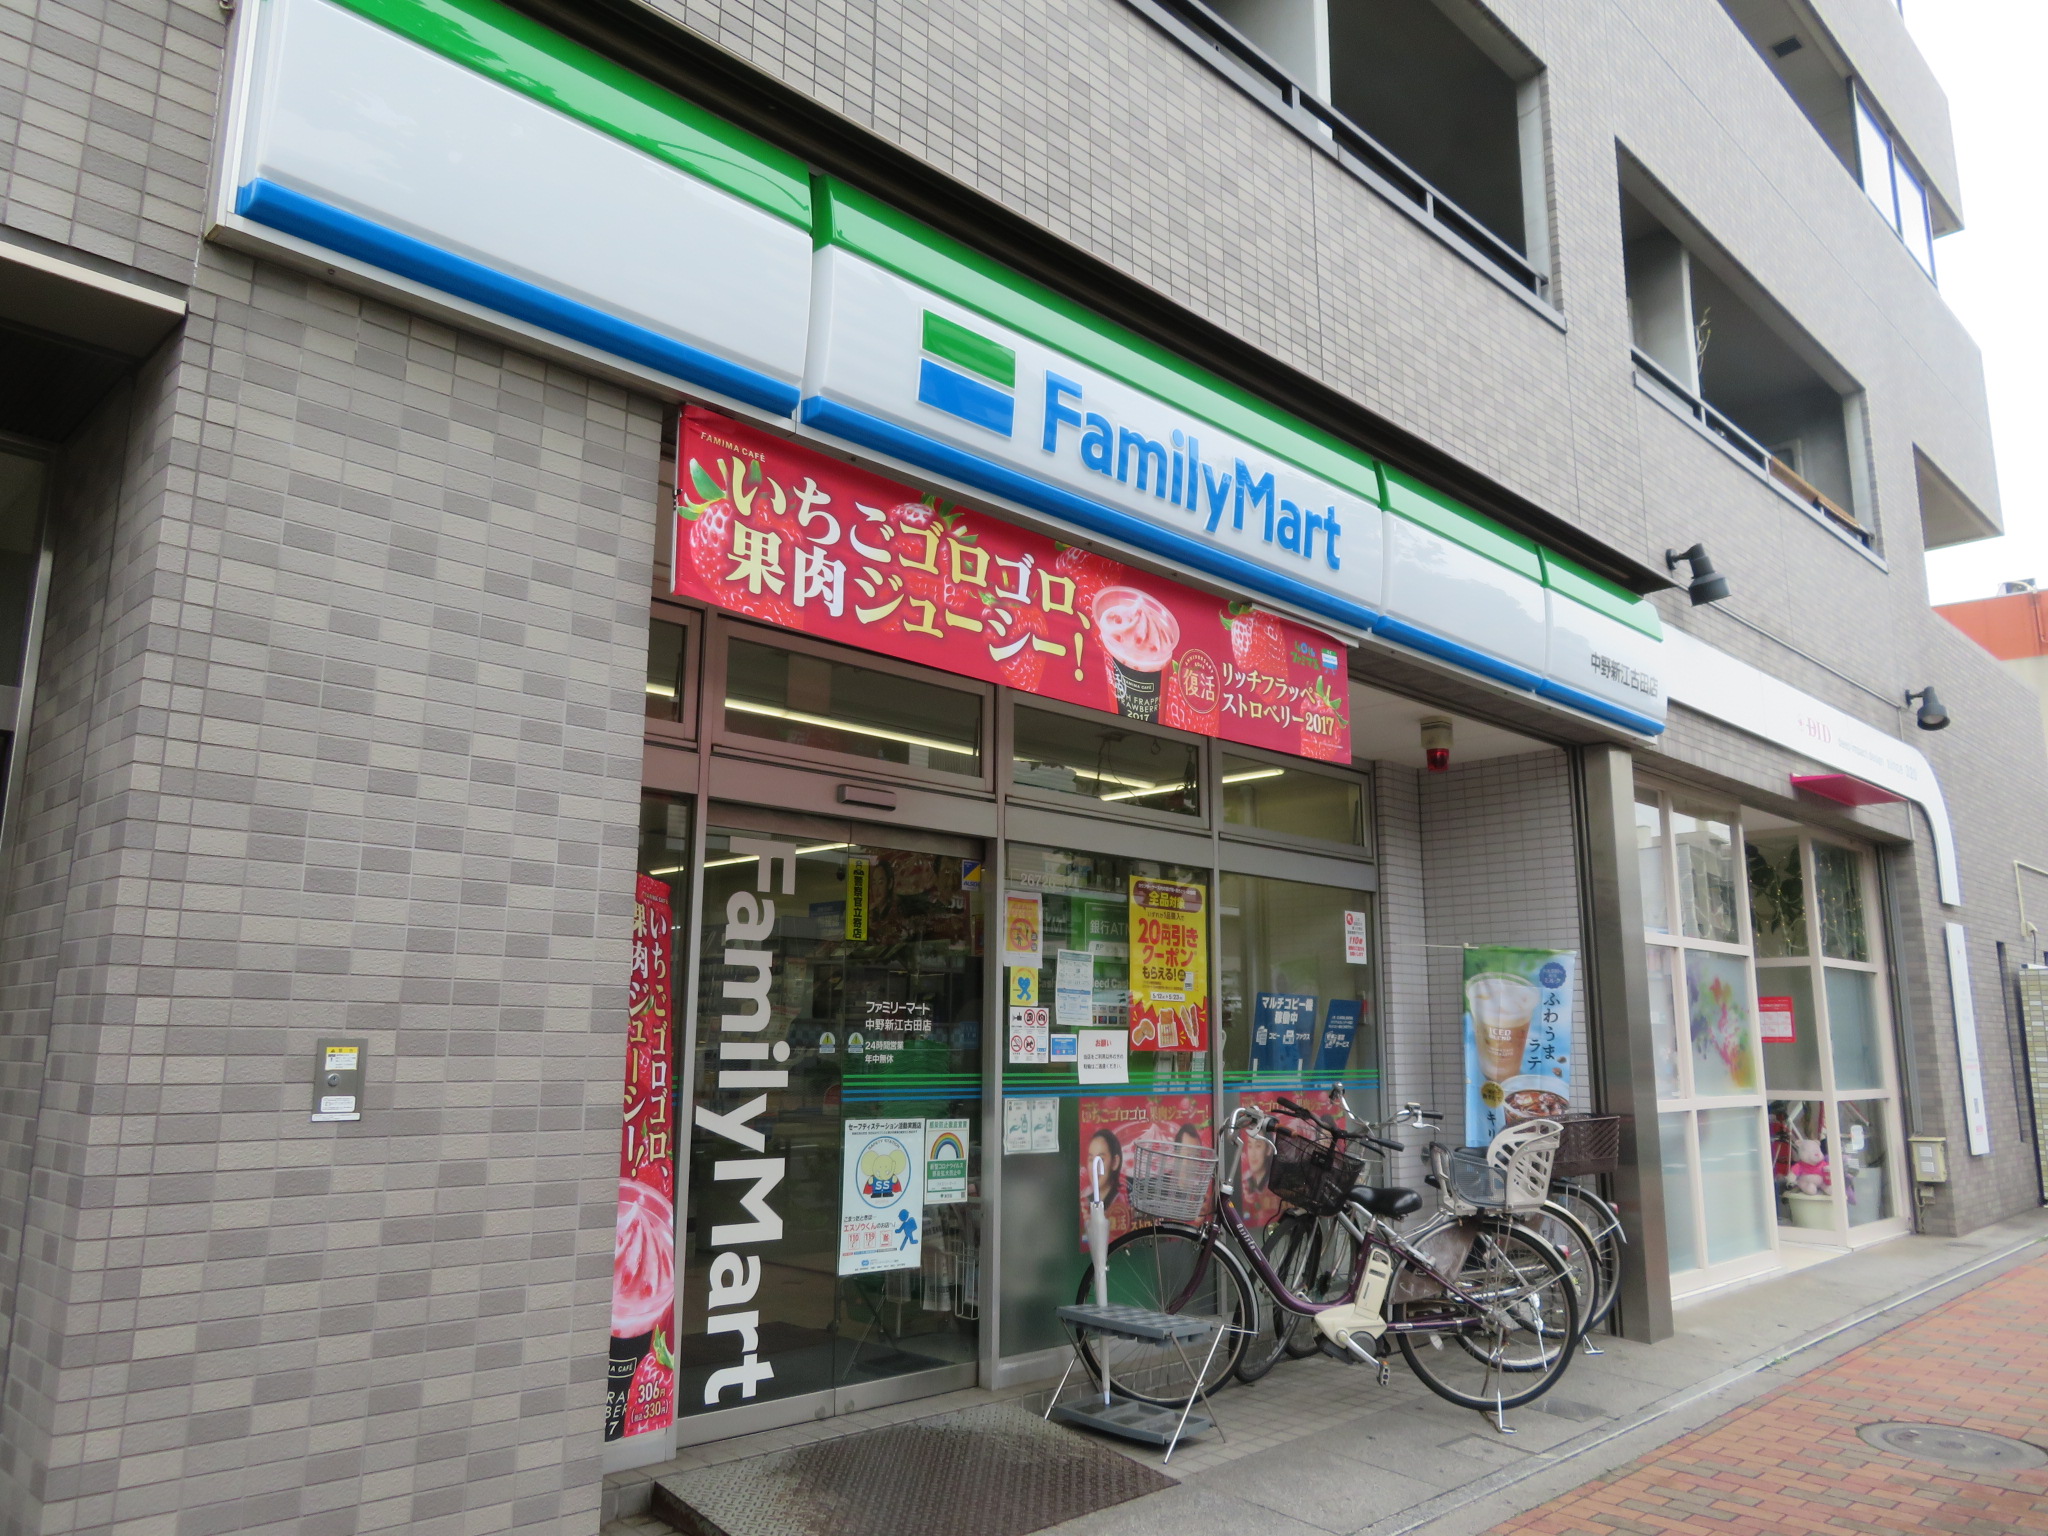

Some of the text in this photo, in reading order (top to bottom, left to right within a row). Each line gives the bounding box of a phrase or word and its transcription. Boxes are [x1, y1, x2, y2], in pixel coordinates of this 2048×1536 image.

[700, 431, 766, 463] FAMIMA CAFÉ
[1043, 369, 1341, 570] FamilyMart
[1184, 669, 1216, 702] 復活
[1222, 662, 1316, 704] リッチフラッペ
[1591, 653, 1658, 696] 中野新江古田店
[1221, 692, 1335, 736] ストロベリー2017
[1138, 917, 1198, 948] 20円引き
[1142, 945, 1194, 967] クーポン
[866, 1001, 931, 1015] ファミリーマート
[865, 1018, 932, 1032] 中野新江古田店
[1543, 993, 1560, 1060] ふわうま
[865, 1041, 904, 1051] 24時間営業
[865, 1054, 894, 1064] 年中無休
[1528, 1039, 1542, 1070] ラテ
[695, 836, 797, 1405] FamilyMart
[875, 1181, 890, 1190] SS
[638, 1380, 666, 1403] 306円
